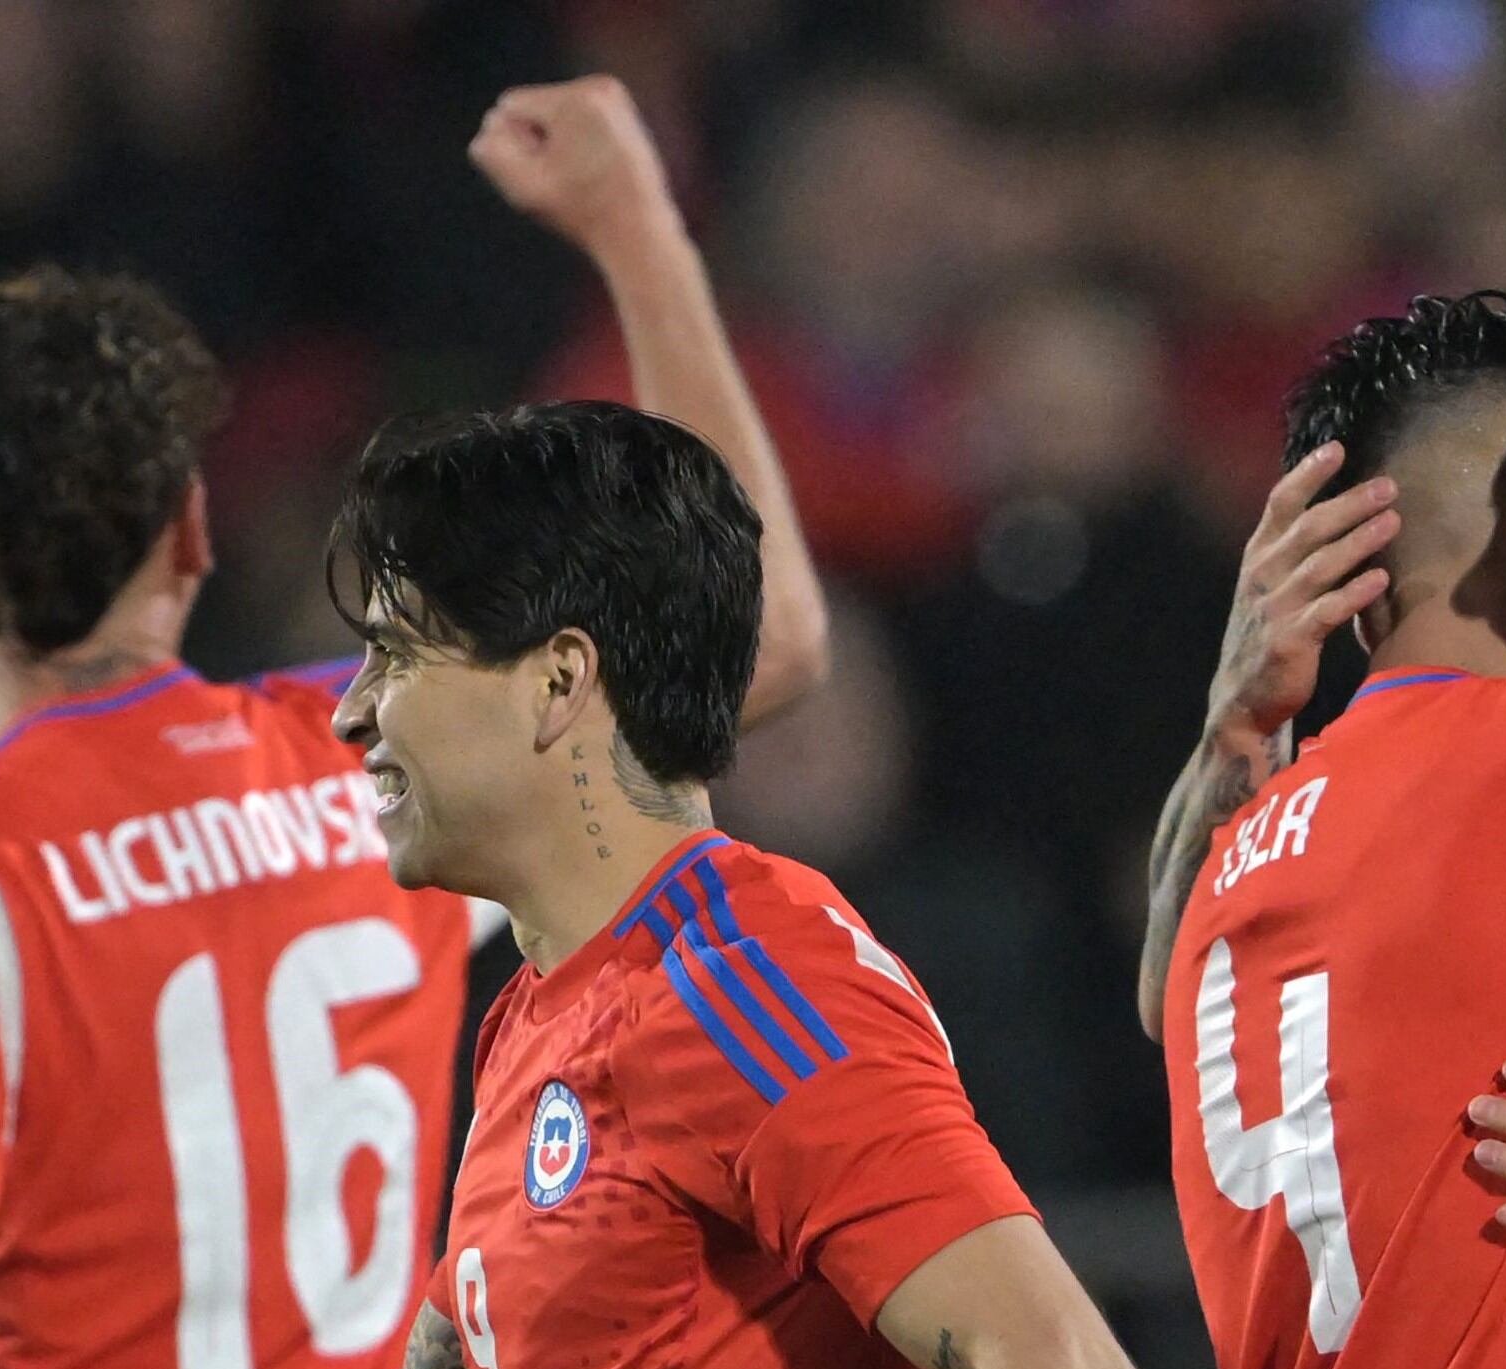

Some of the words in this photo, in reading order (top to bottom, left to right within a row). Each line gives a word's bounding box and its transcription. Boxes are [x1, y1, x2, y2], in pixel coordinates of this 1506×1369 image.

[38, 769, 390, 925] LICHNOVSK
[1213, 775, 1328, 897] ISLA
[1194, 935, 1362, 1355] 4
